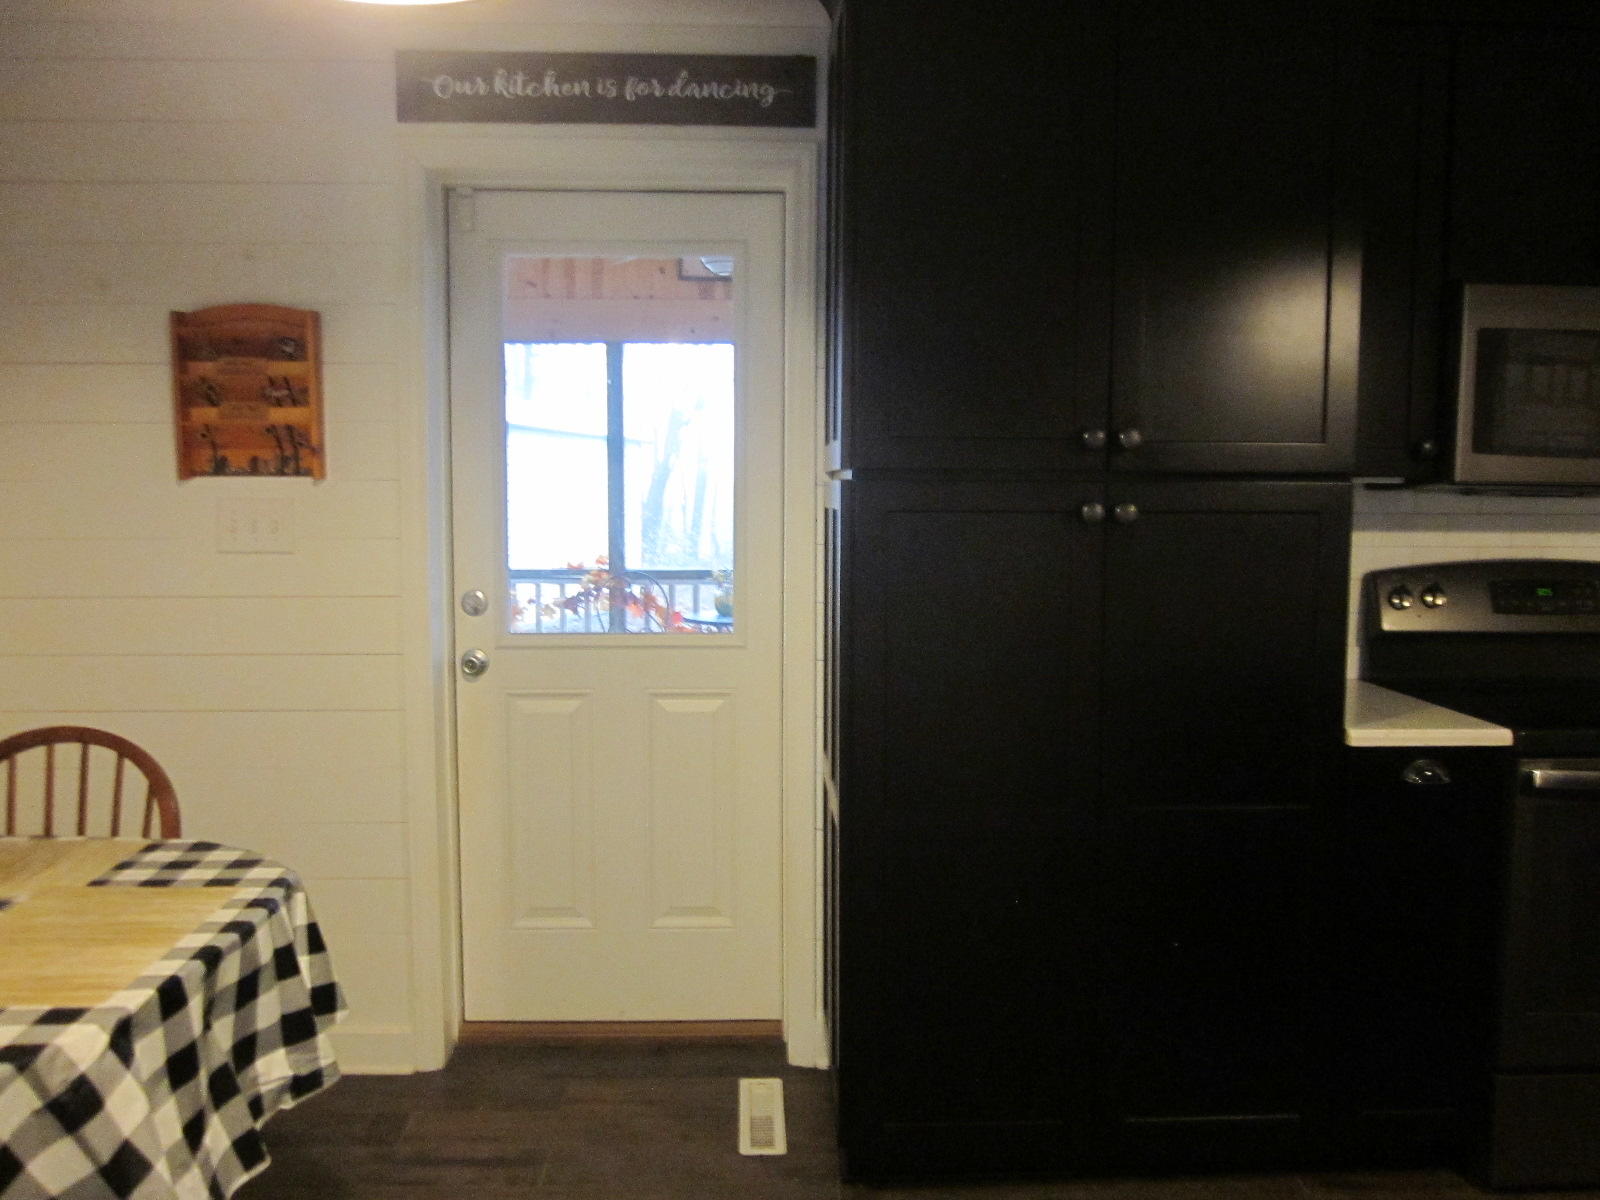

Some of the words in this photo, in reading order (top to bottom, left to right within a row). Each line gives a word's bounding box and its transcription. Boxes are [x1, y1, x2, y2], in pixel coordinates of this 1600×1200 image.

[429, 75, 489, 99] Our
[493, 68, 591, 99] kitchen
[597, 76, 618, 98] is
[624, 76, 668, 101] for
[667, 70, 785, 107] dancing
